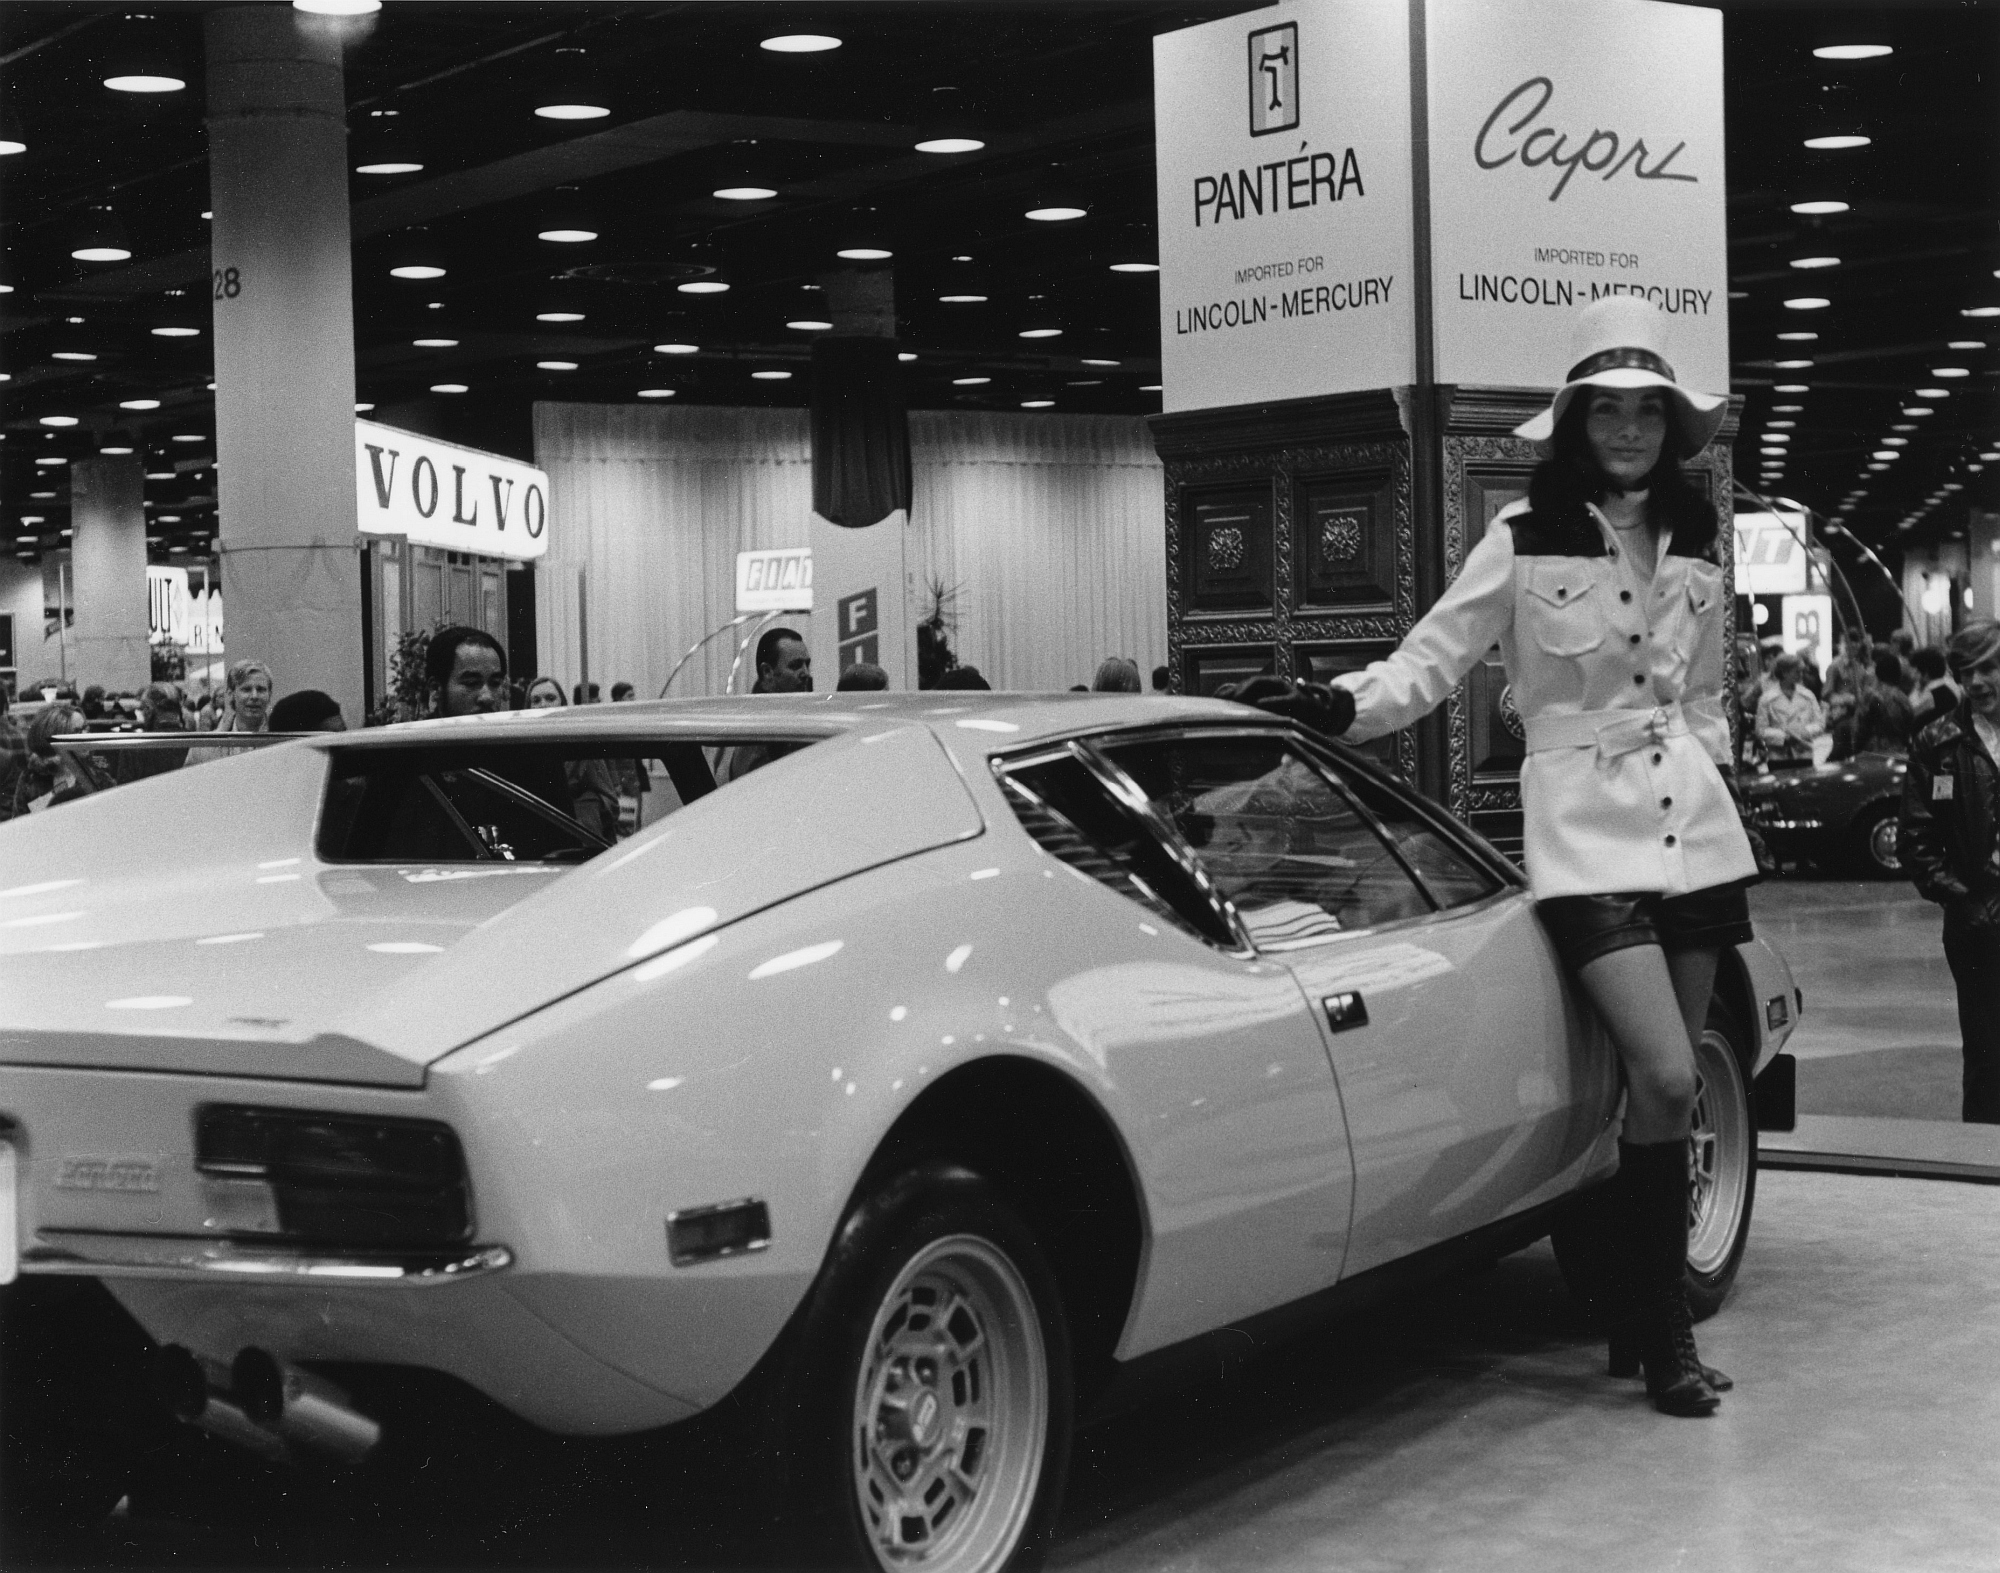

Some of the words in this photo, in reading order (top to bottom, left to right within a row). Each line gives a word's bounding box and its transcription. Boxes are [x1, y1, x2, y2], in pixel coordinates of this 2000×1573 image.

[1474, 77, 1697, 201] Capri
[1234, 261, 1293, 285] IMPORTED
[1298, 255, 1324, 274] FOR
[1535, 248, 1605, 267] IMPORTED
[1610, 253, 1639, 268] FOR
[1177, 276, 1394, 334] LINCOLN-MERCURY
[364, 443, 545, 539] VOLVO
